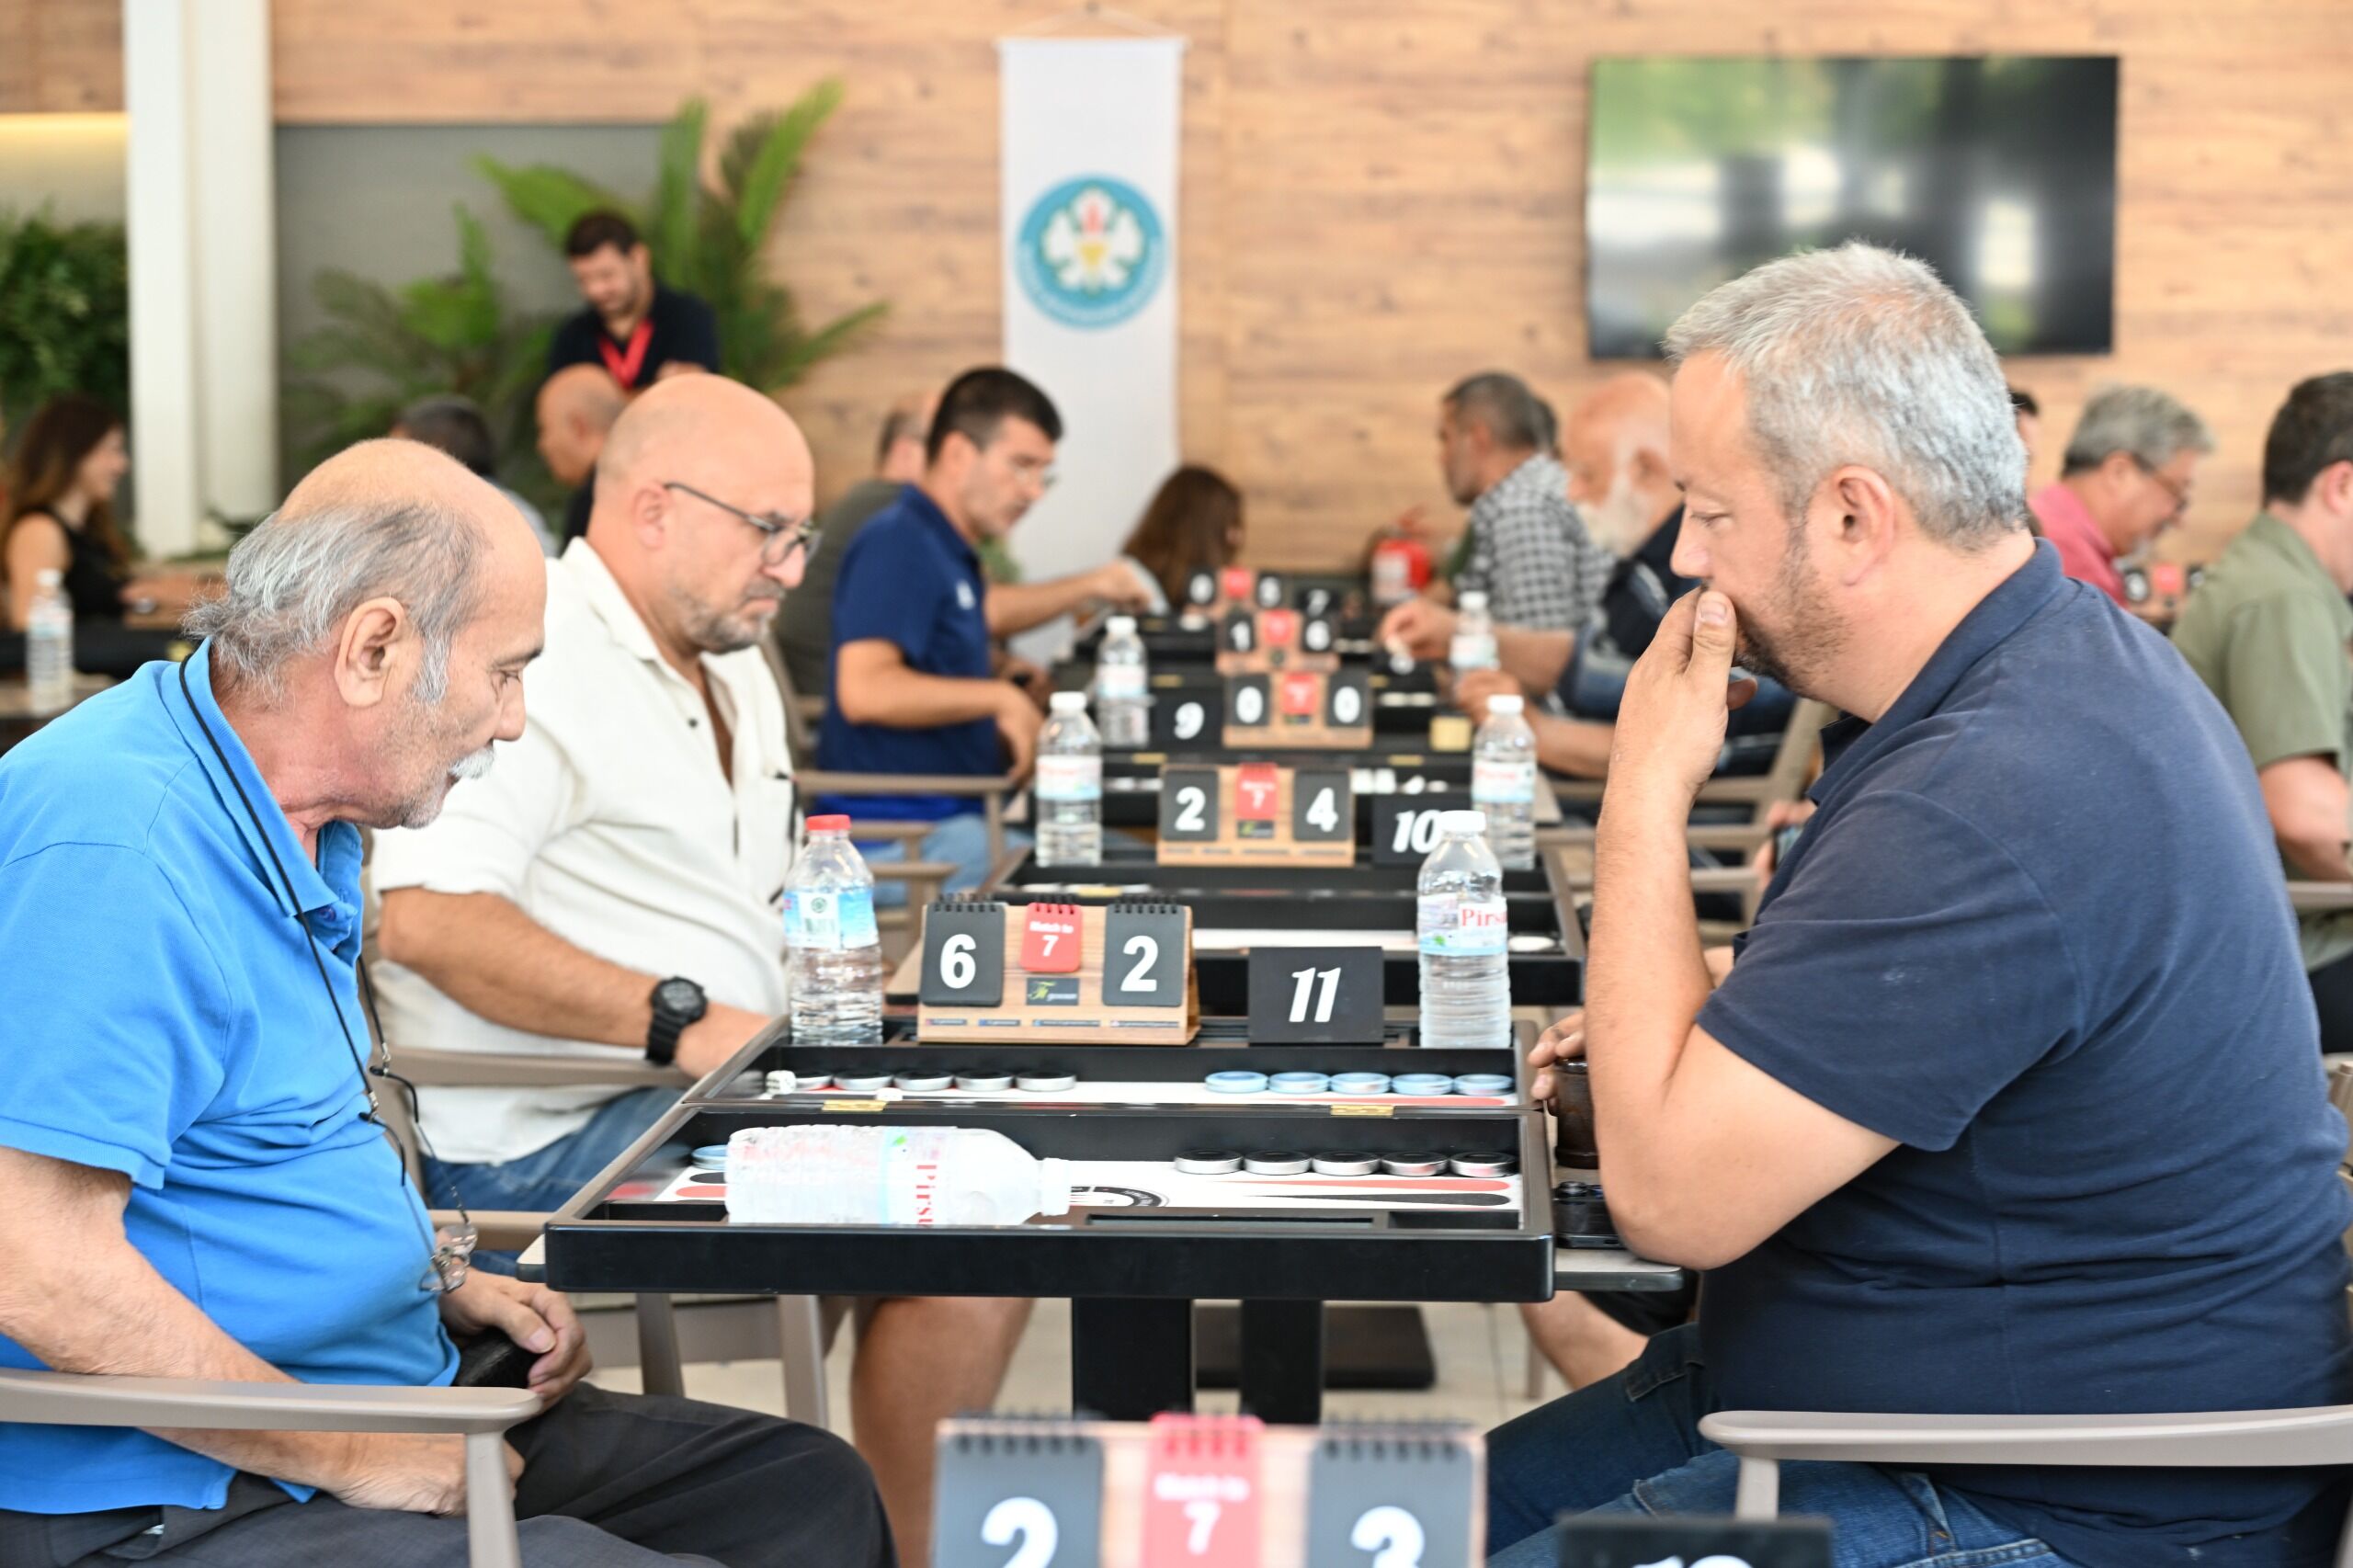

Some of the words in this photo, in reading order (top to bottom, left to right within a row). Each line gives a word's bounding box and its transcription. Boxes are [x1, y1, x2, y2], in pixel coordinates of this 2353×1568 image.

[1174, 702, 1204, 739] 9
[1235, 686, 1264, 724] 0
[1334, 686, 1361, 723] 0
[1175, 786, 1206, 832] 2
[1306, 787, 1339, 832] 4
[1392, 809, 1440, 853] 10
[940, 933, 976, 989] 6
[1042, 934, 1060, 957] 7
[1120, 935, 1159, 992] 2
[1289, 967, 1341, 1023] 11
[981, 1496, 1058, 1568] 2
[1184, 1500, 1221, 1555] 7
